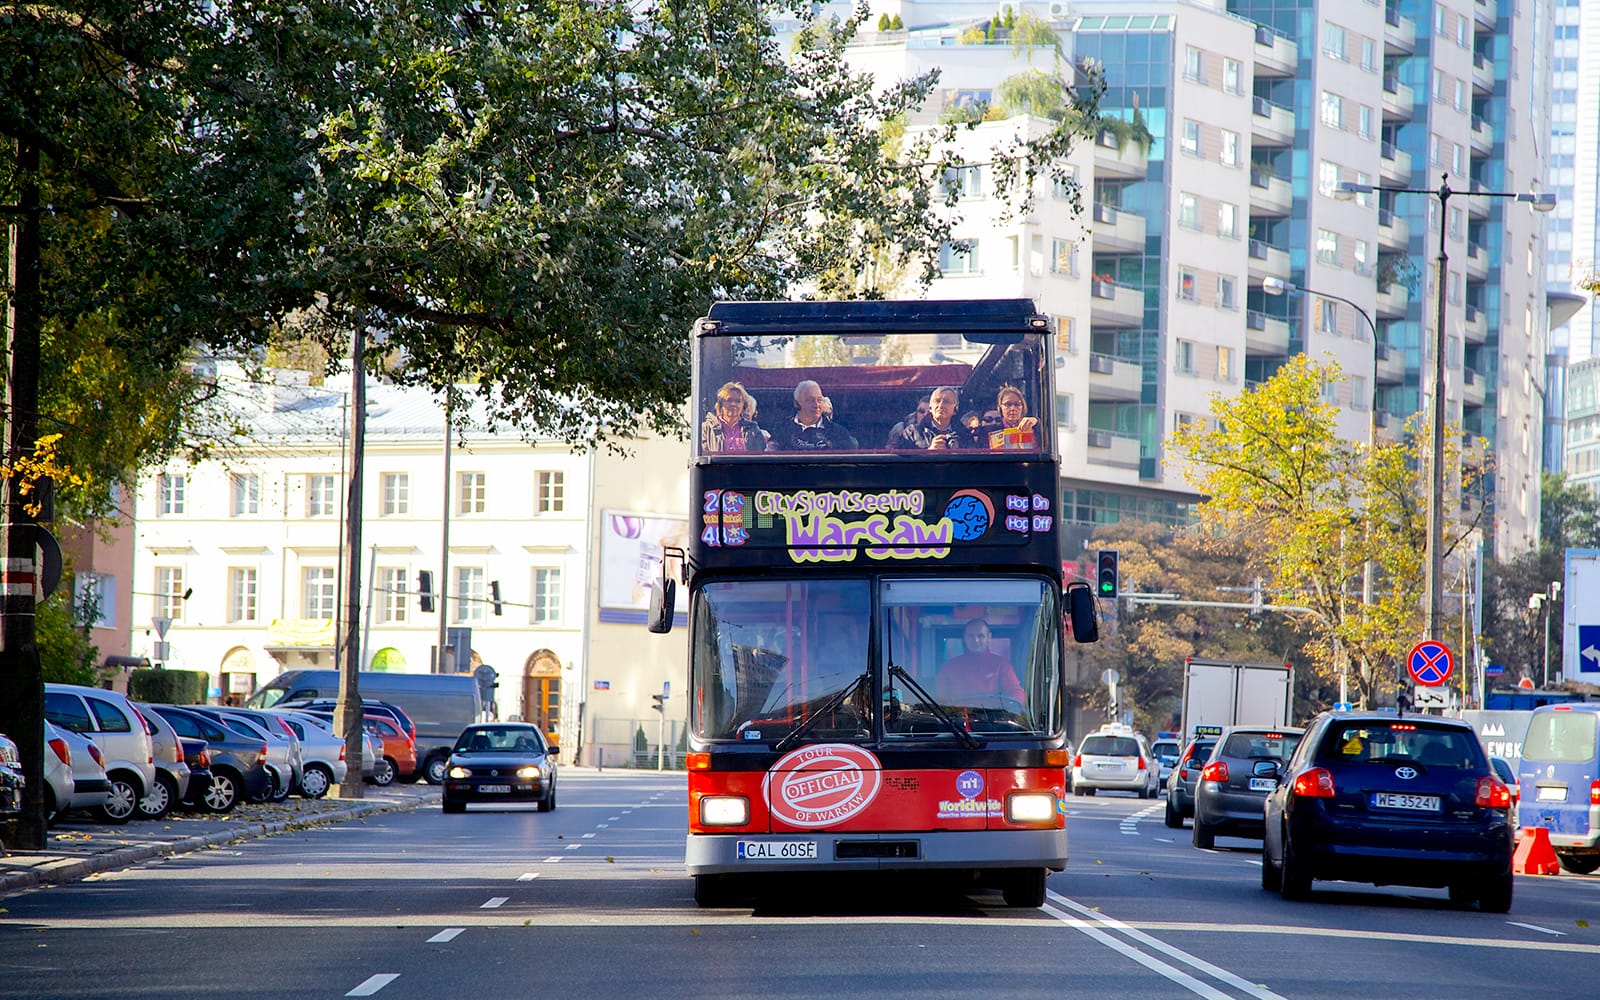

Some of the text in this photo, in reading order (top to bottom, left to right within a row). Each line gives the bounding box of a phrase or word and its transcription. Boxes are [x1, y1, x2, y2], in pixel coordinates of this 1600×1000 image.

[1033, 496, 1049, 509] On
[1033, 516, 1051, 530] Off
[788, 514, 951, 561] Warsaw
[797, 747, 834, 763] TOUR
[787, 770, 860, 799] OFFICIAL
[796, 793, 865, 821] OF WARSAW
[1379, 794, 1439, 809] WE 3524V
[747, 843, 776, 857] CAL
